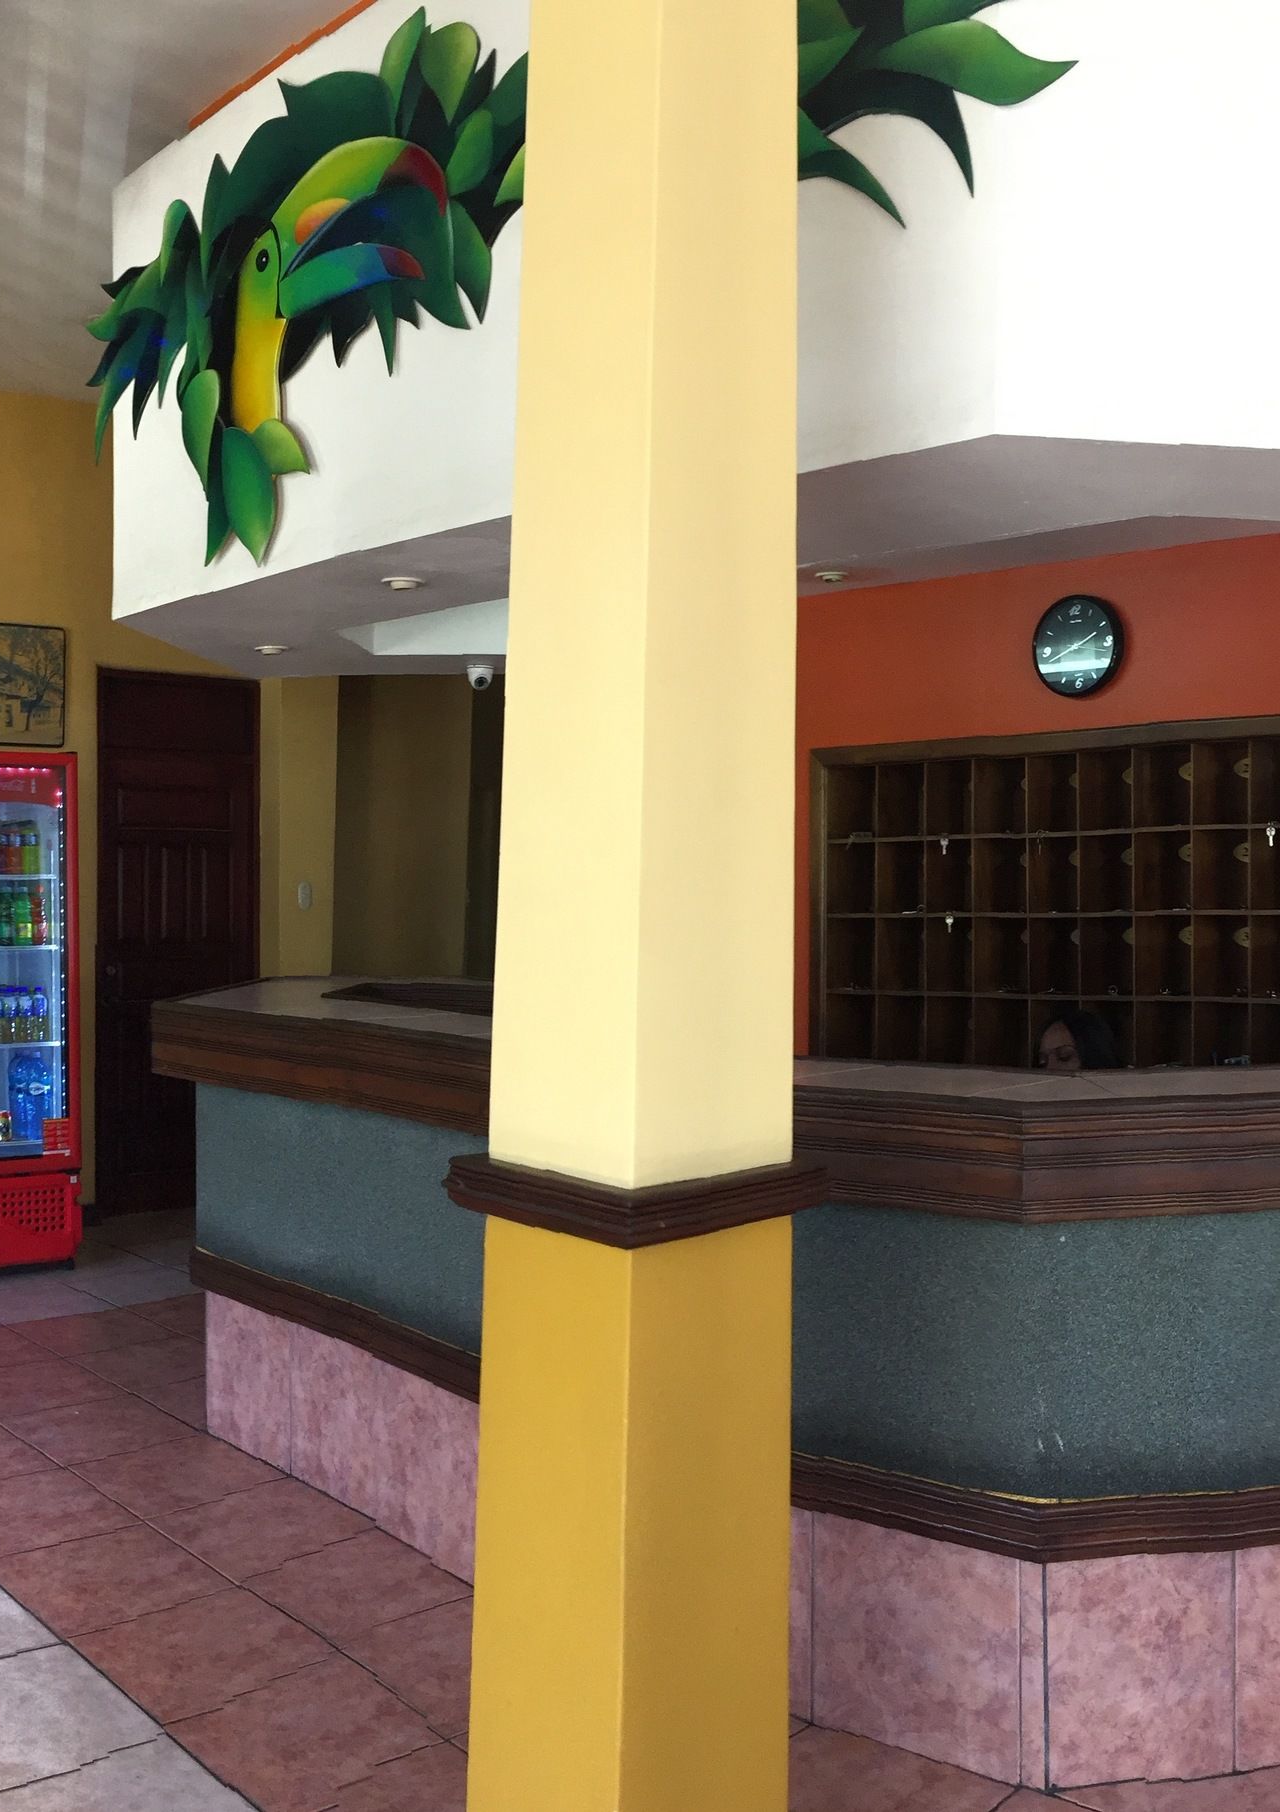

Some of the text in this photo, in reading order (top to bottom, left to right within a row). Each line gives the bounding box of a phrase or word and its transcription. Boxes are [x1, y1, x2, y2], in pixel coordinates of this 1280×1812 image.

[1068, 604, 1081, 616] 12
[1103, 635, 1113, 647] 3
[1042, 646, 1052, 658] 9
[1075, 677, 1084, 689] 6
